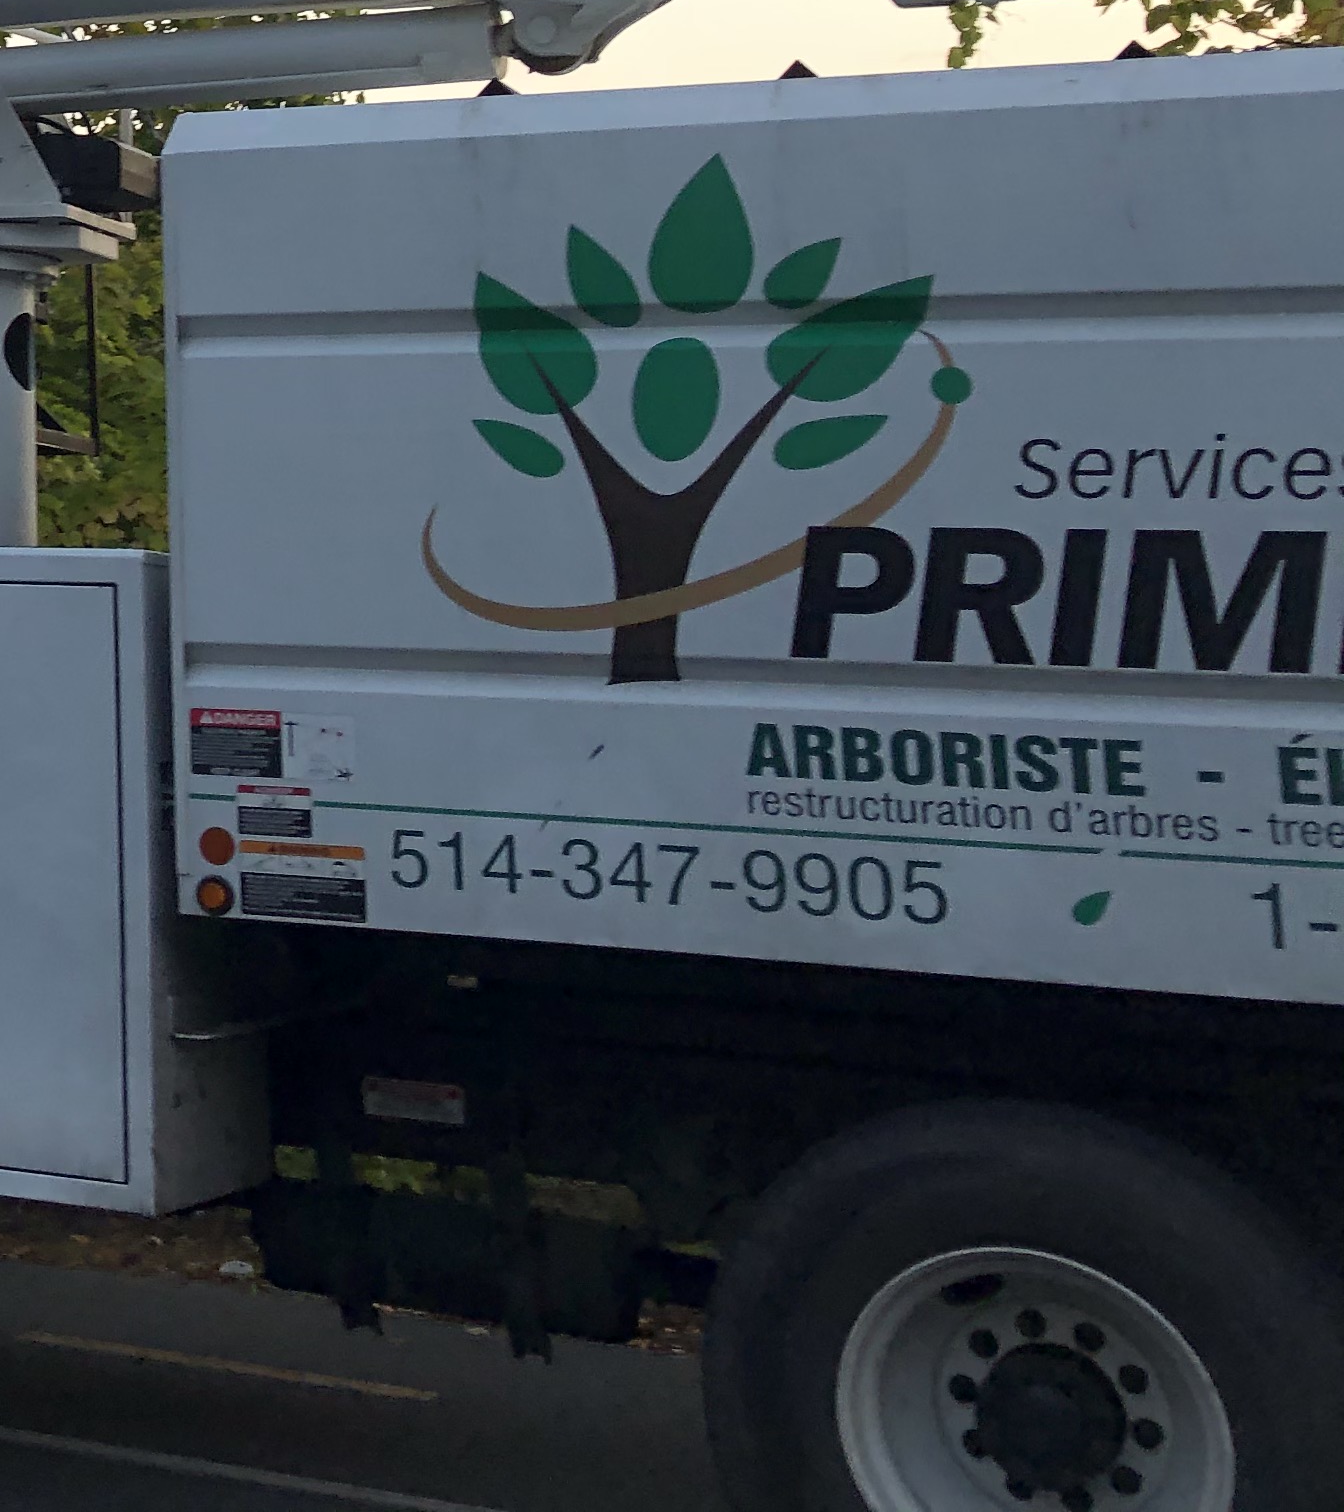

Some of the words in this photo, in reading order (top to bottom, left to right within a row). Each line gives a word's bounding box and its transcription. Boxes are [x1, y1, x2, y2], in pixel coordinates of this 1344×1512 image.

[1014, 434, 1344, 501] Service
[789, 525, 1344, 675] PRIM
[746, 722, 1146, 797] ARBORISTE
[746, 787, 1033, 831] restructuration
[1048, 799, 1219, 842] d'arbres
[390, 829, 949, 926] 514-347-9905
